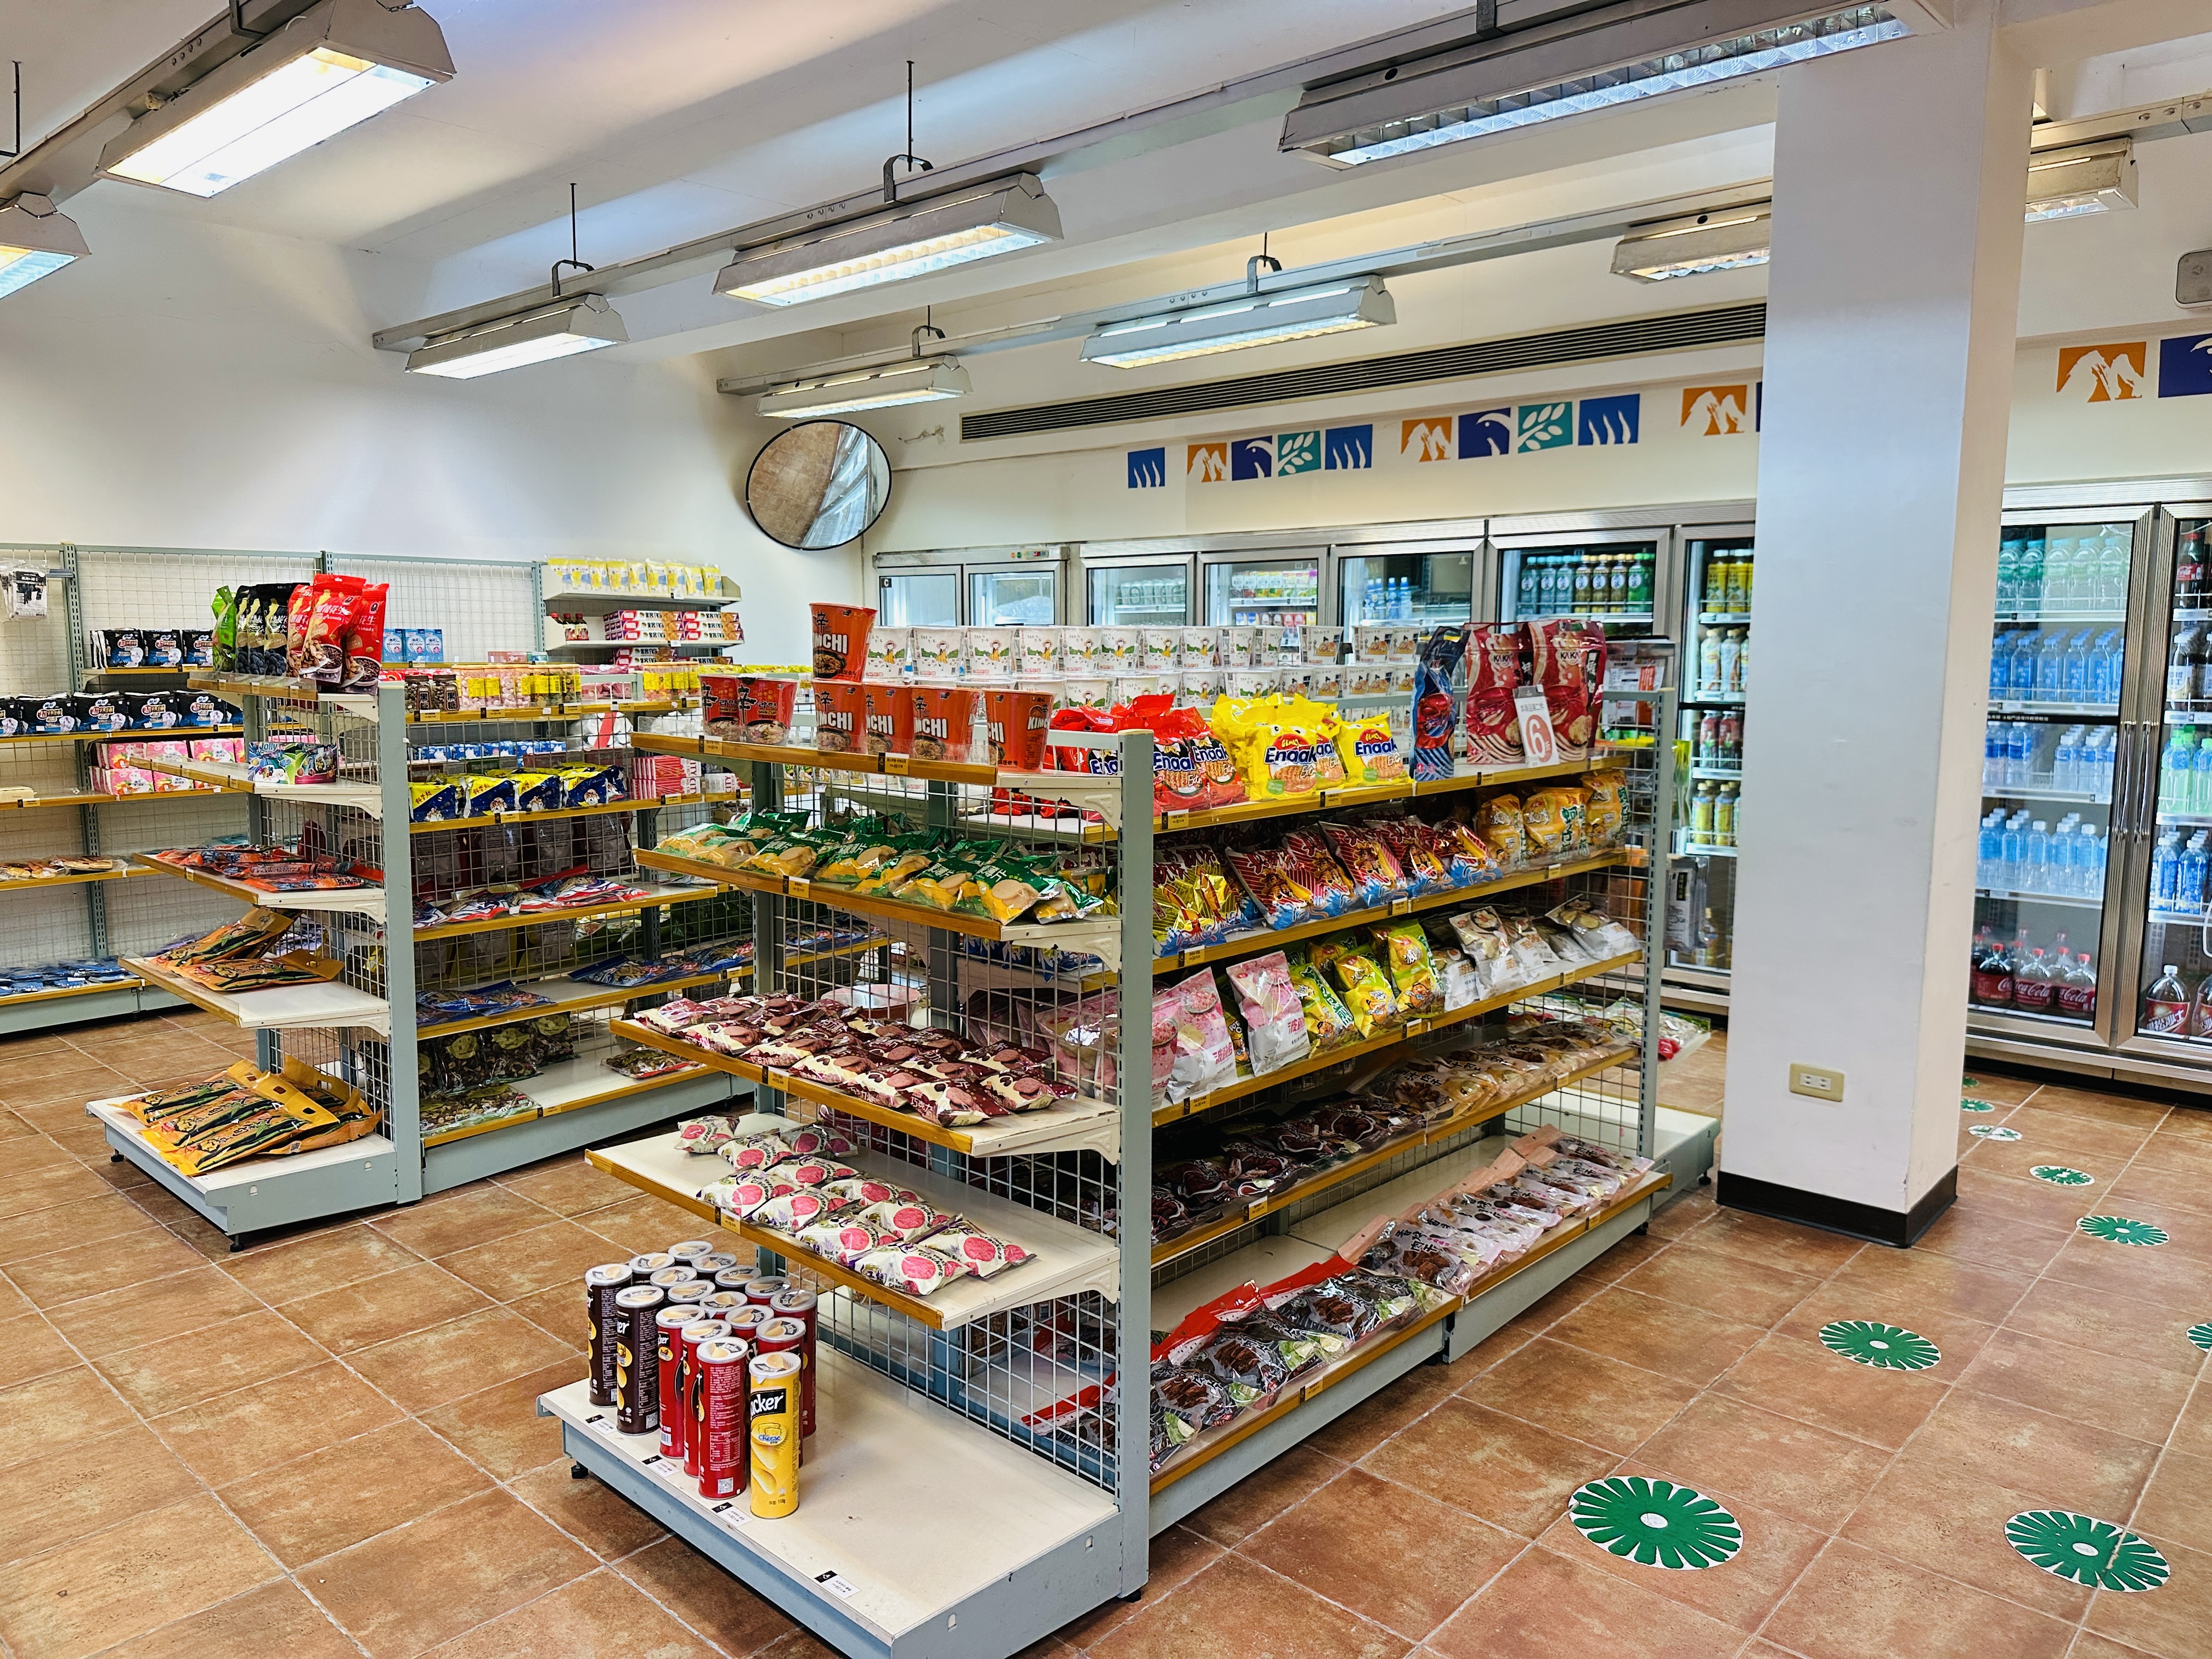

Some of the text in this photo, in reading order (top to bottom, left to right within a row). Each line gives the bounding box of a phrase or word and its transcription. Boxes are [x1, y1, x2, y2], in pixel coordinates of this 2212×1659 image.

[816, 712, 853, 731] IMCHI
[1528, 719, 1546, 760] 6
[1090, 759, 1118, 775] Ena
[751, 1394, 783, 1421] acker
[758, 1434, 782, 1442] Cheese
